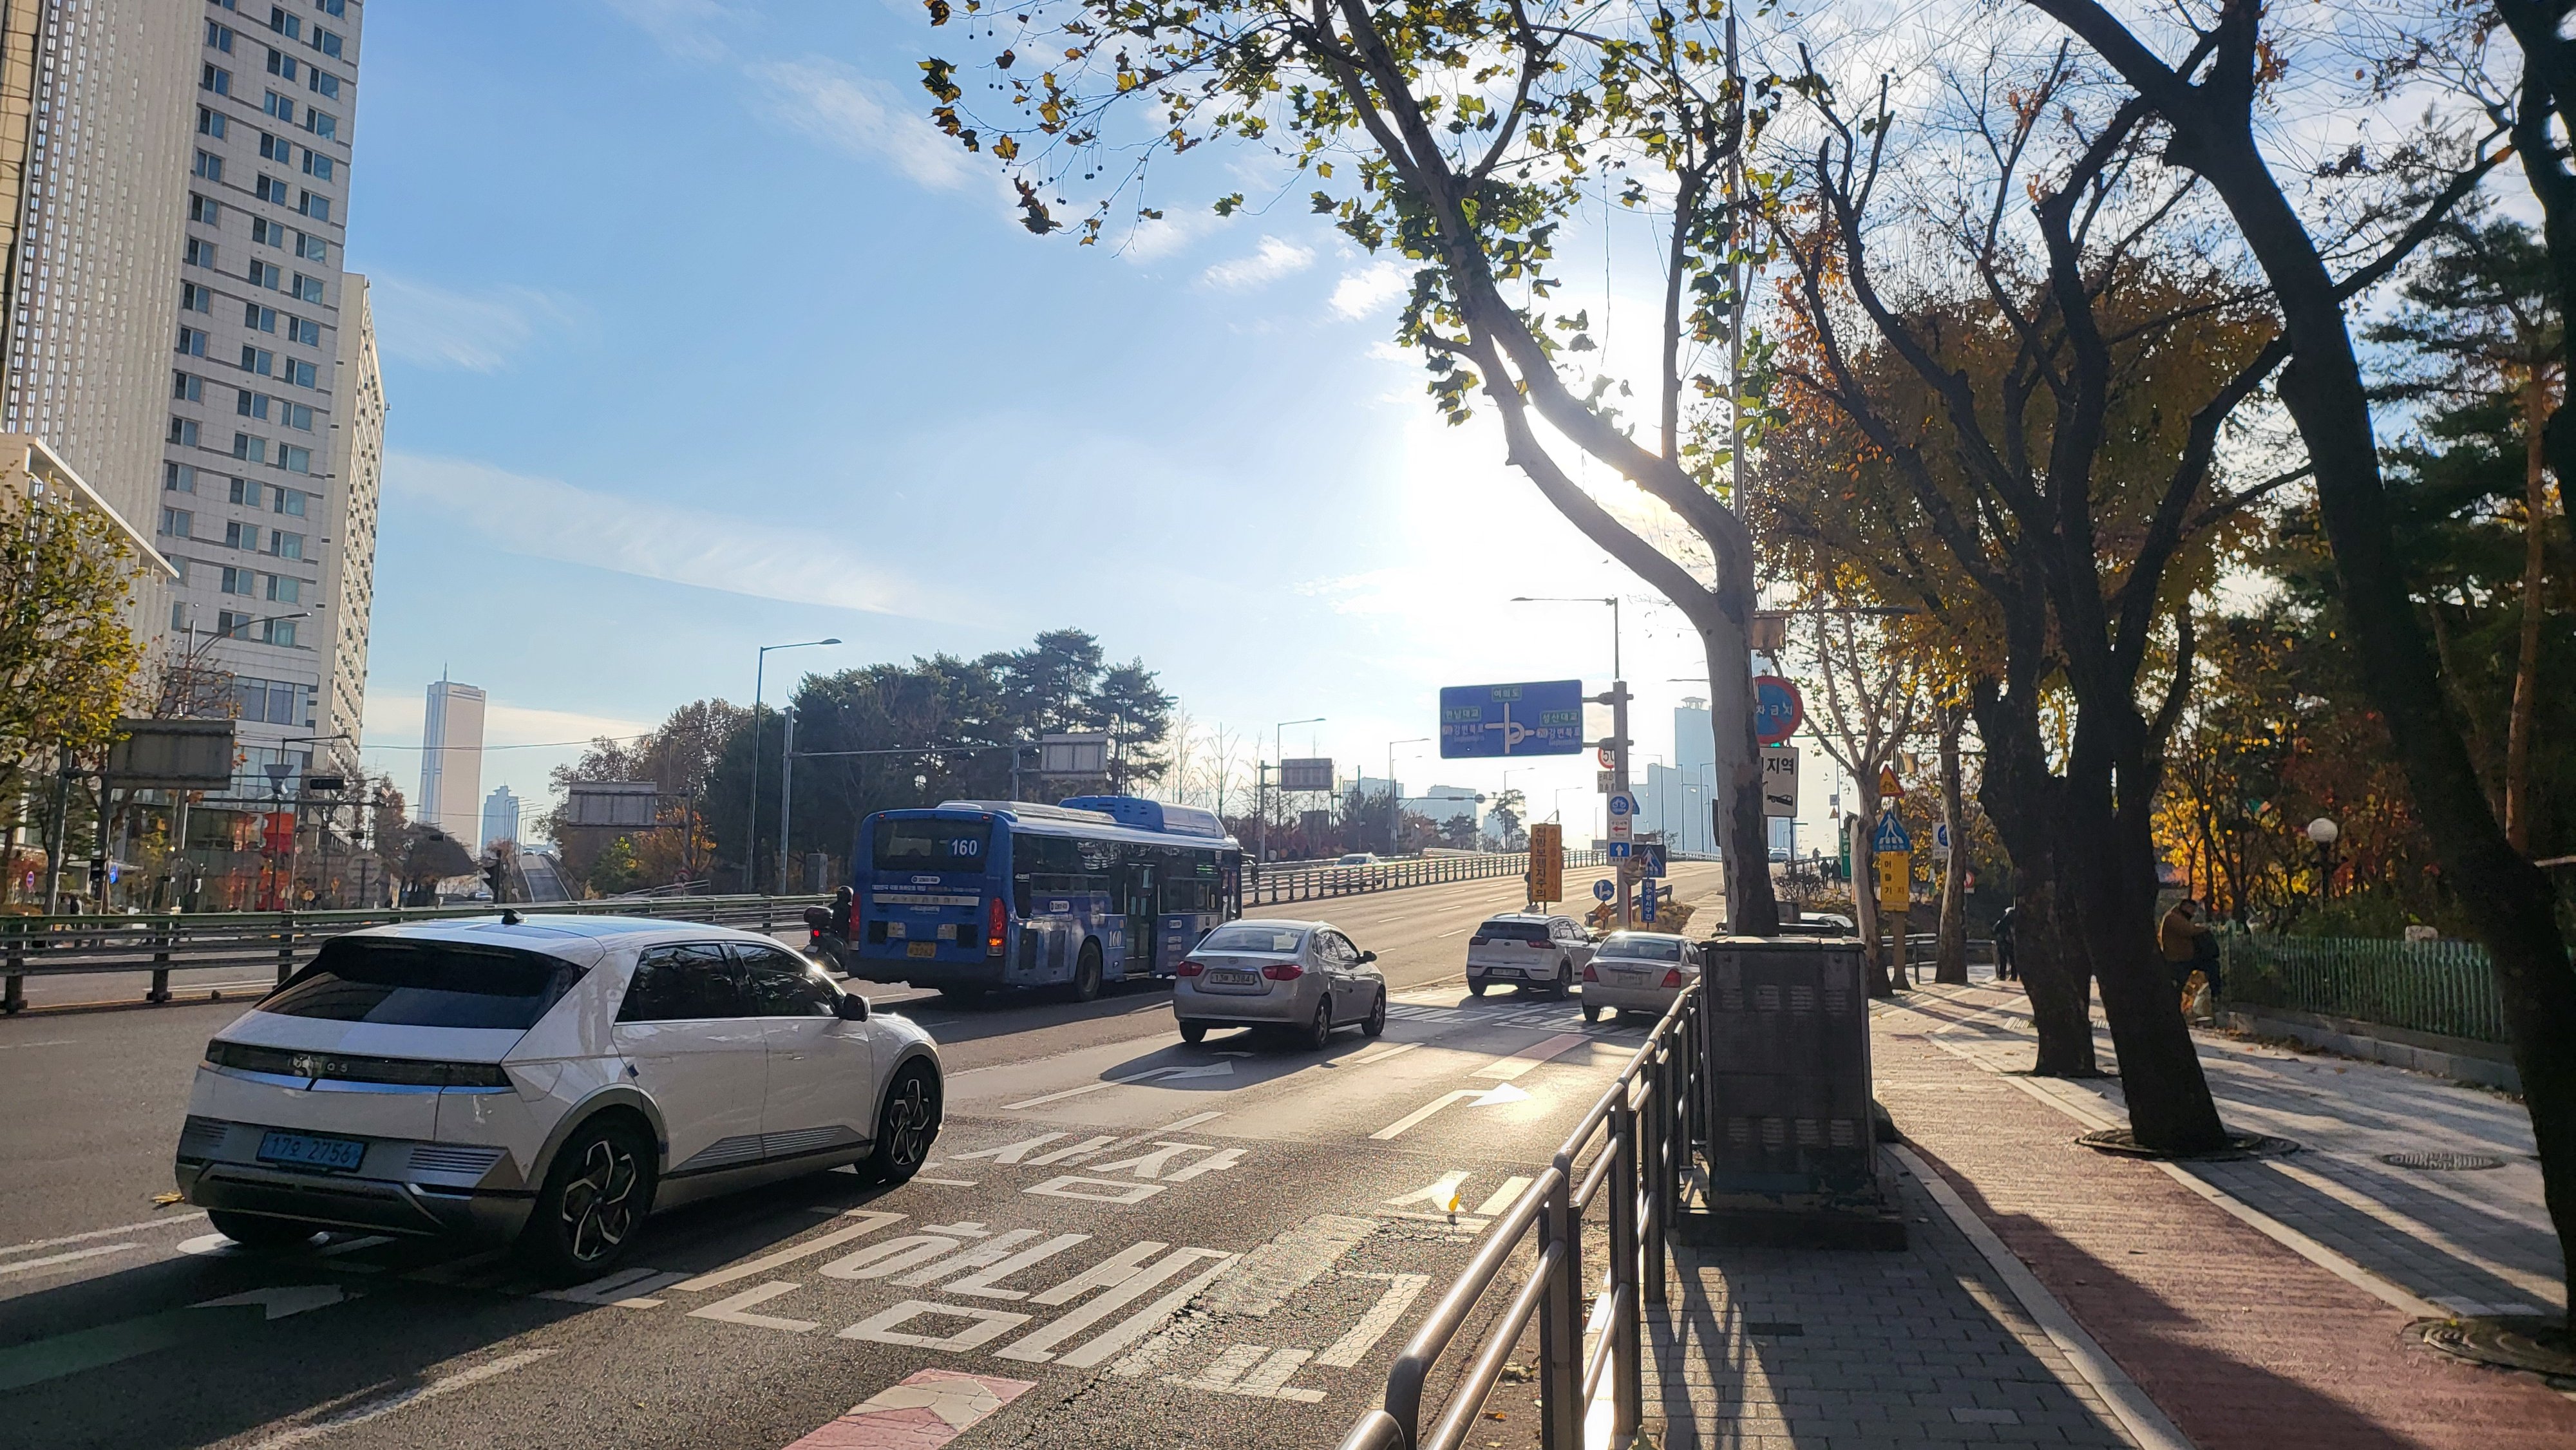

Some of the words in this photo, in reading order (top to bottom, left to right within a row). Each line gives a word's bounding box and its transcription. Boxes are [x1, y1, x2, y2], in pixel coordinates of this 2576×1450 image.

[1493, 688, 1520, 699] 여의도
[1542, 712, 1577, 724] 성산대교
[1756, 704, 1793, 716] 차금지
[1761, 757, 1794, 775] 지역
[952, 839, 977, 856] 160
[1108, 930, 1122, 947] 160
[271, 1136, 301, 1156] 17오
[307, 1140, 352, 1164] 2756
